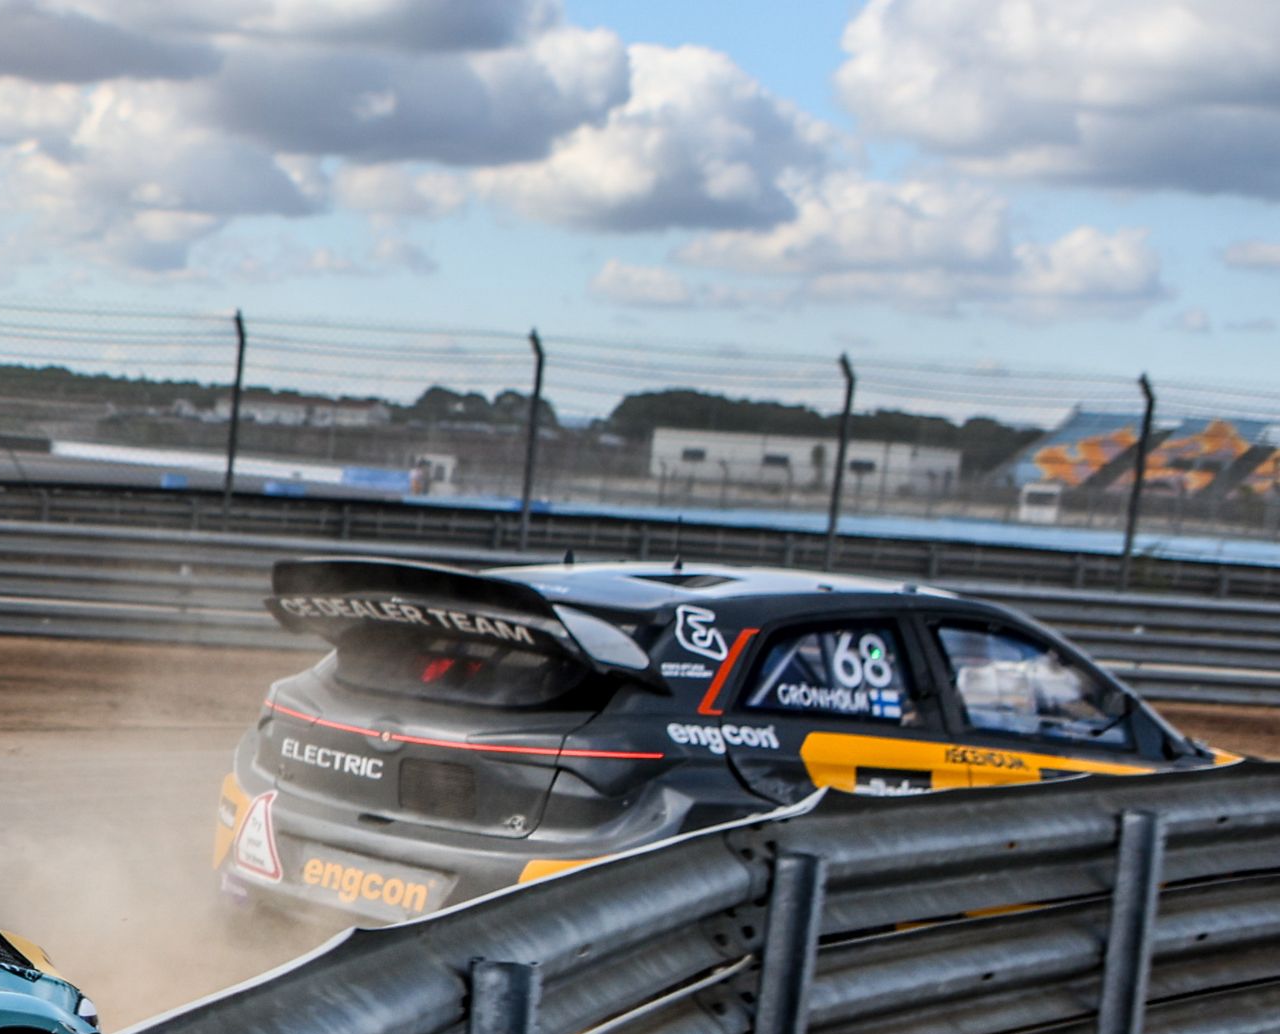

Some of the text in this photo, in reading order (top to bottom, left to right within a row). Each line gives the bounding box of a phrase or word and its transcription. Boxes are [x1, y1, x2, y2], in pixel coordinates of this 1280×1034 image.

[316, 599, 429, 625] DEALER
[427, 608, 535, 645] TEAM
[833, 631, 893, 689] 68
[281, 738, 384, 779] ELECTRIC
[666, 723, 779, 755] engcon
[303, 858, 429, 913] engcon
